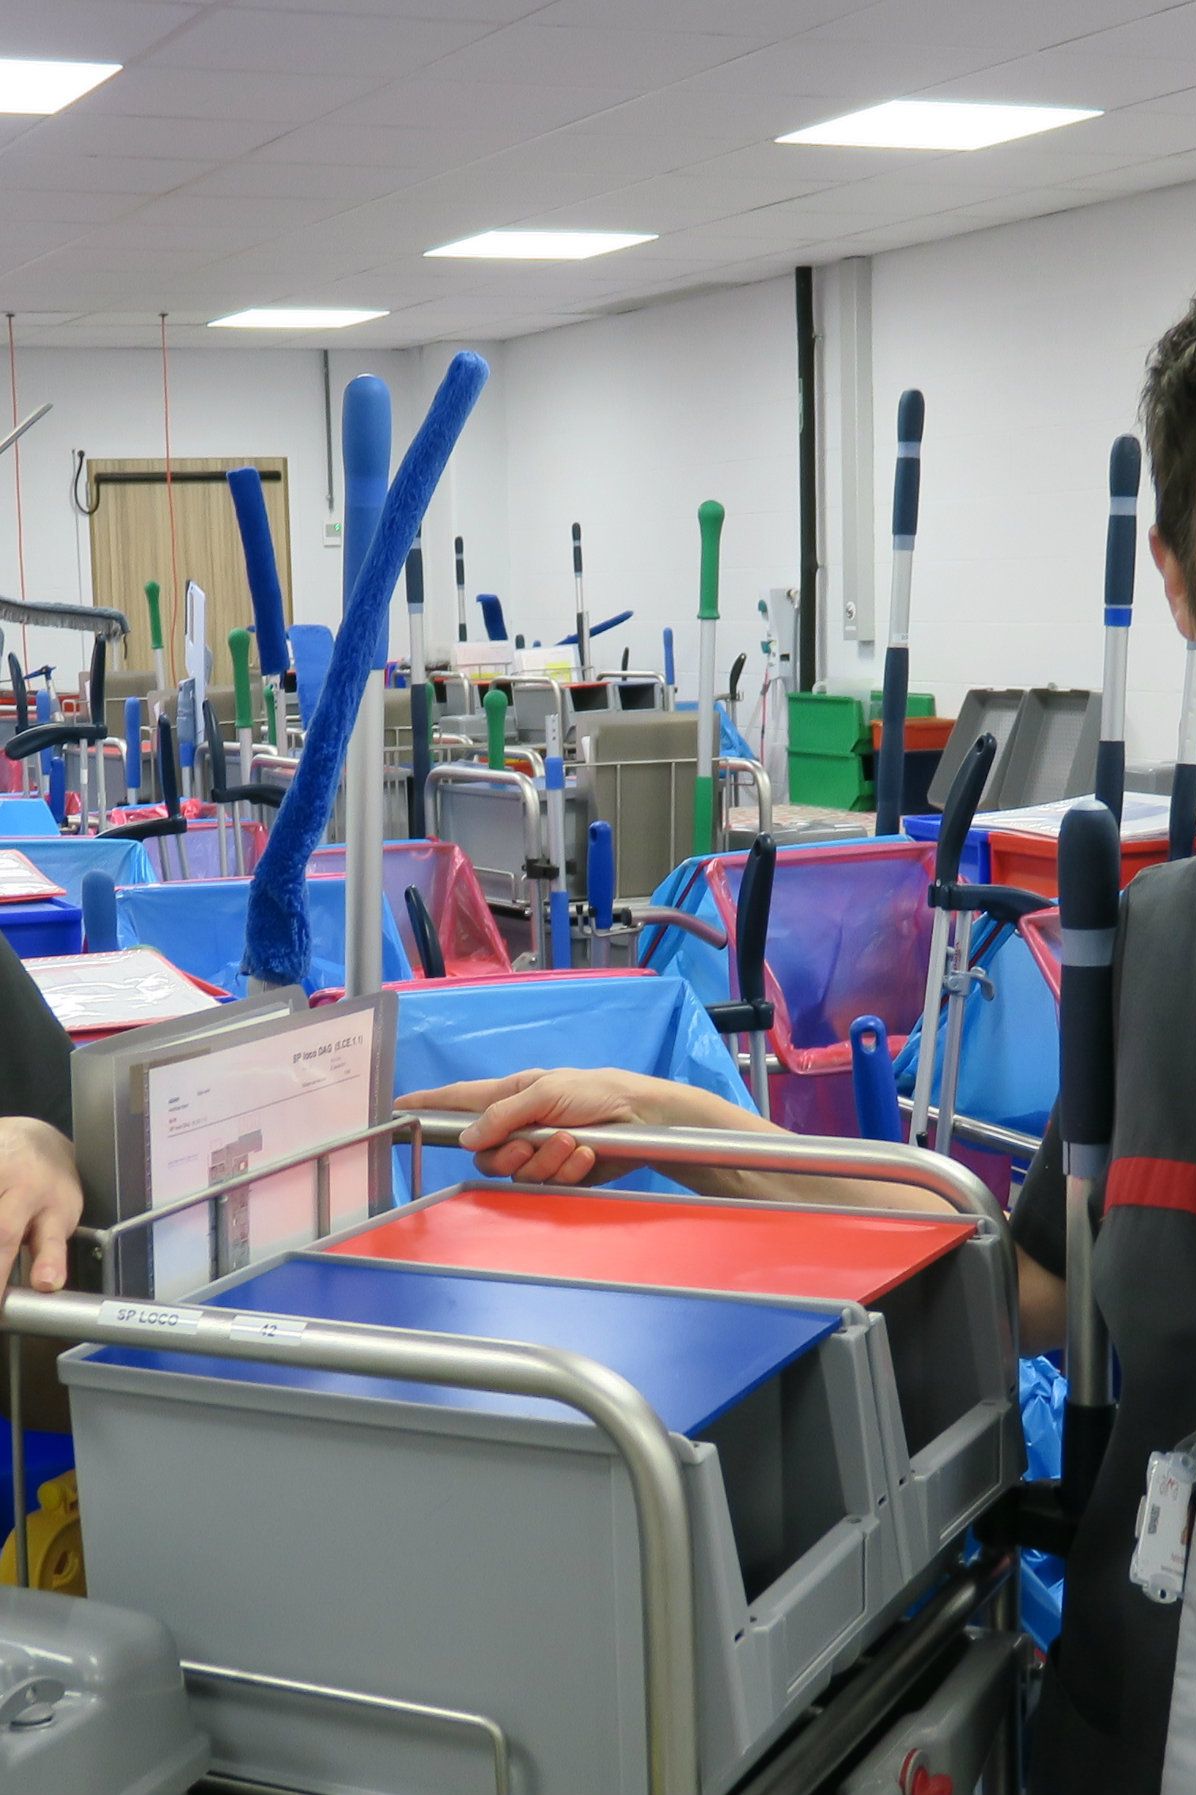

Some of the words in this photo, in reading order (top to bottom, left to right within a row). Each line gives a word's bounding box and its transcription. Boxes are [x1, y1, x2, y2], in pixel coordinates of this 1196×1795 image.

[117, 1308, 137, 1322] SP
[138, 1311, 180, 1327] LOCO
[261, 1323, 278, 1338] 42
